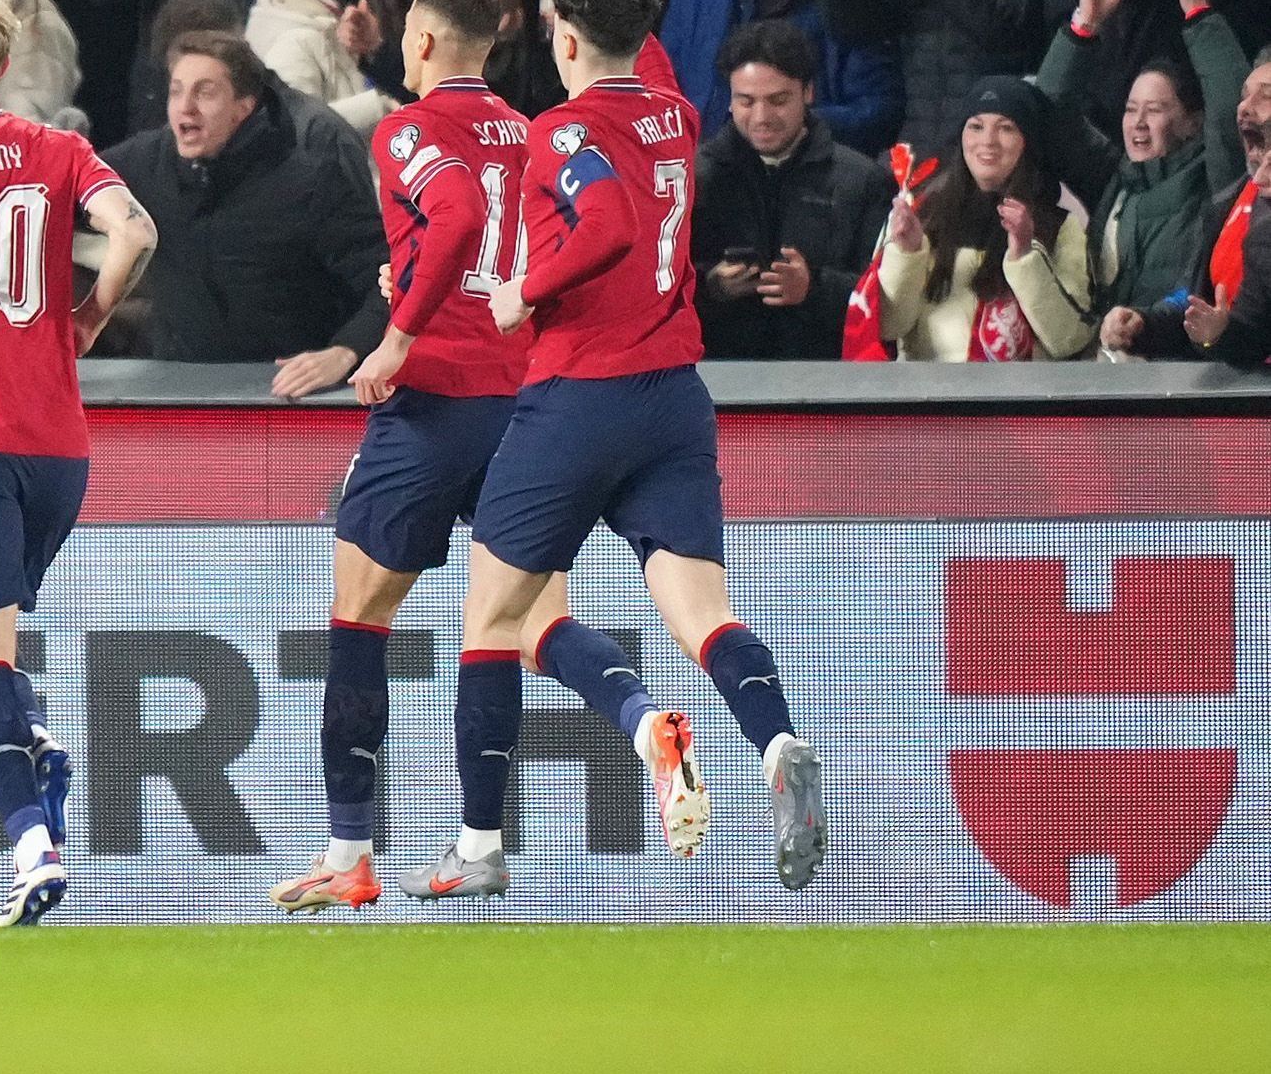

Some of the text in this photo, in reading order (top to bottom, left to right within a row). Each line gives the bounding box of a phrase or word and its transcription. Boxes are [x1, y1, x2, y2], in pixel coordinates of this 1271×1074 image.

[461, 162, 528, 299] 1
[560, 168, 580, 196] C
[654, 159, 689, 295] 7
